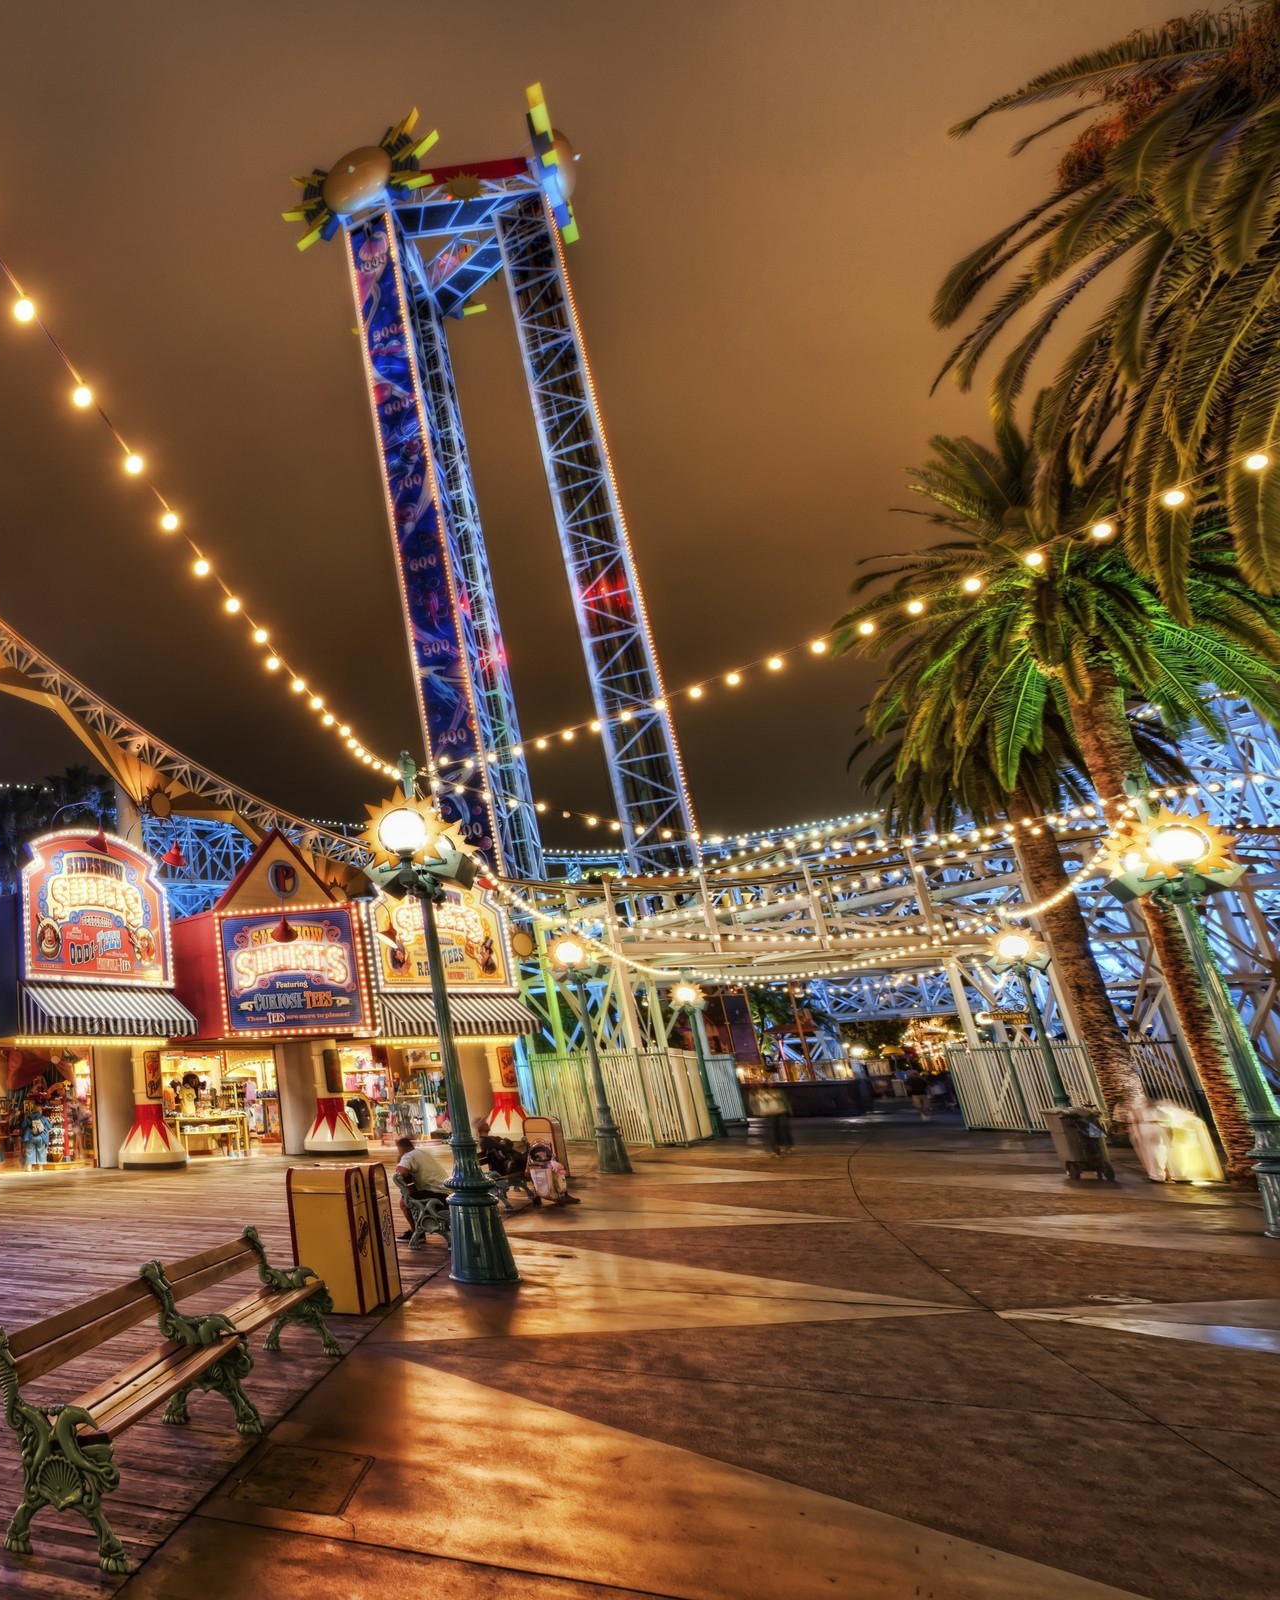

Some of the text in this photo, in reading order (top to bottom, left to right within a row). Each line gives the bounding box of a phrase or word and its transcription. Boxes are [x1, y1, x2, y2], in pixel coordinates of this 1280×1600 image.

[360, 253, 387, 273] 1000
[372, 323, 398, 342] 900
[398, 473, 422, 492] 700
[410, 553, 437, 572] 600
[423, 639, 450, 657] 500
[438, 727, 467, 745] 400
[461, 822, 483, 839] 00
[66, 856, 123, 879] SIDESHOW
[274, 865, 295, 892] P
[52, 877, 142, 927] SHIRTS
[234, 944, 348, 990] SHIRTS
[276, 980, 308, 988] Featuring
[254, 991, 333, 1011] CURIOSI-TEES
[267, 1012, 286, 1024] TEES
